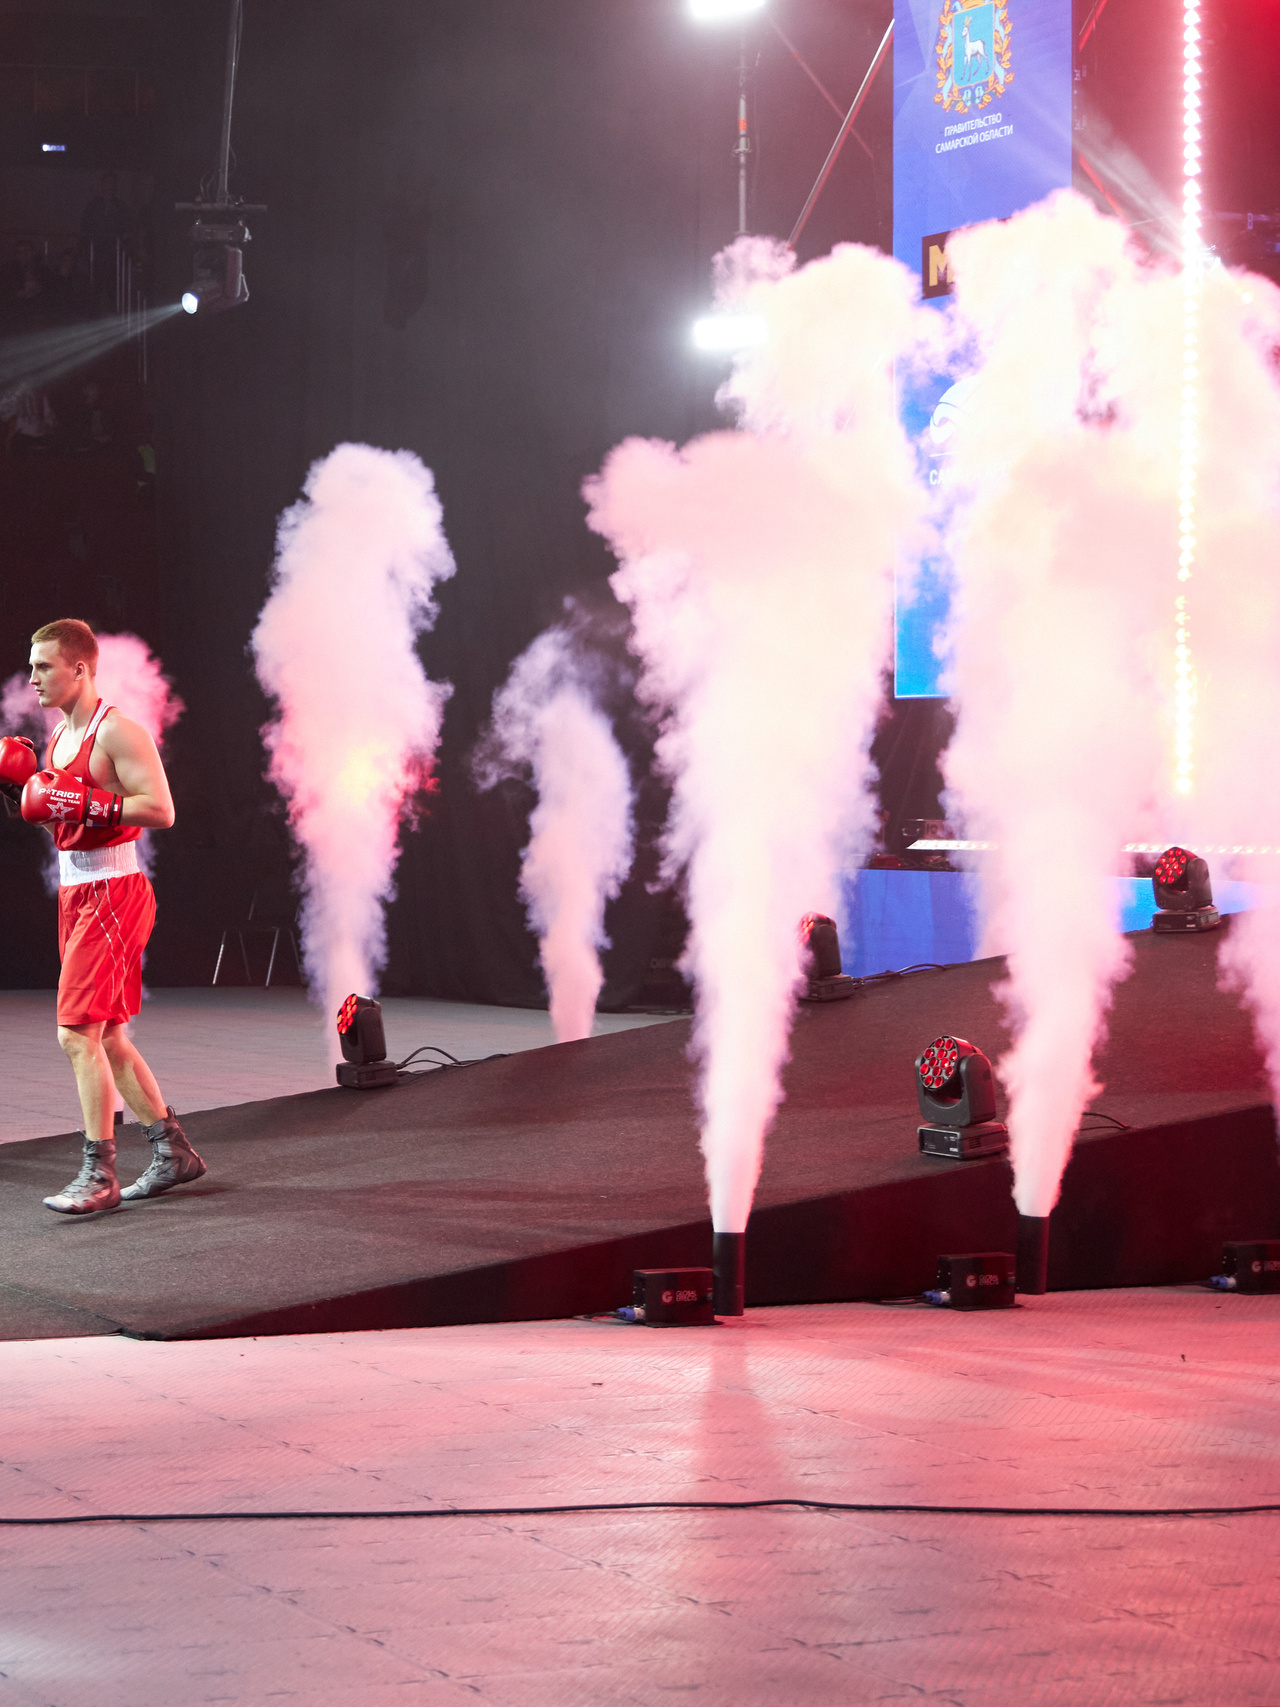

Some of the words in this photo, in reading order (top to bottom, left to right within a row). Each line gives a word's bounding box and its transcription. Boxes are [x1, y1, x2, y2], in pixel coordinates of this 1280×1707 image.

[944, 112, 1002, 137] ПРАВИТЕЛЬСТВО
[935, 132, 979, 154] САМАРСКОЙ
[979, 124, 1014, 143] ОБЛАСТИ
